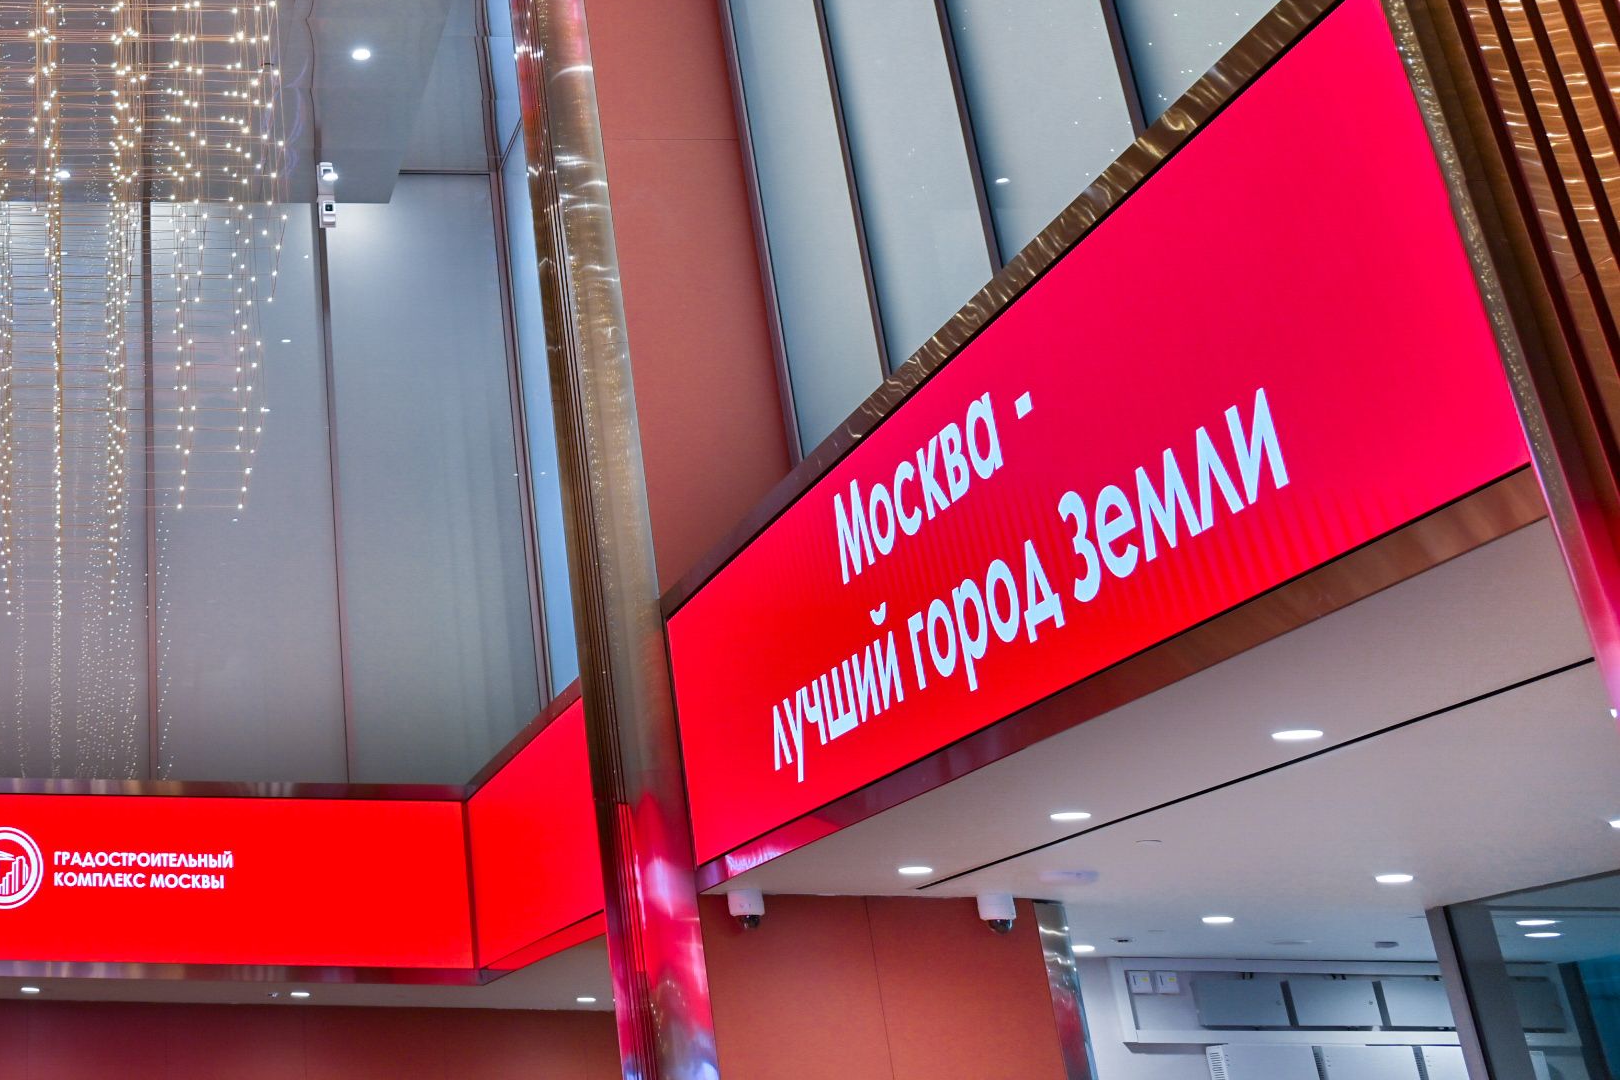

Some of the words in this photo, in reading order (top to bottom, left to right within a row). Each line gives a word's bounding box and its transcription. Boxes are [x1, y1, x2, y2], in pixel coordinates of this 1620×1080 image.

[833, 391, 1004, 585] Москва
[771, 601, 904, 783] лучший
[907, 539, 1066, 692] город
[1057, 387, 1290, 603] Земли
[53, 850, 234, 869] ГРАДОСТРОИТЕЛЬНЫЙ
[53, 871, 146, 888] КОМПЛЕКС
[149, 872, 225, 889] МОСКВЫ
